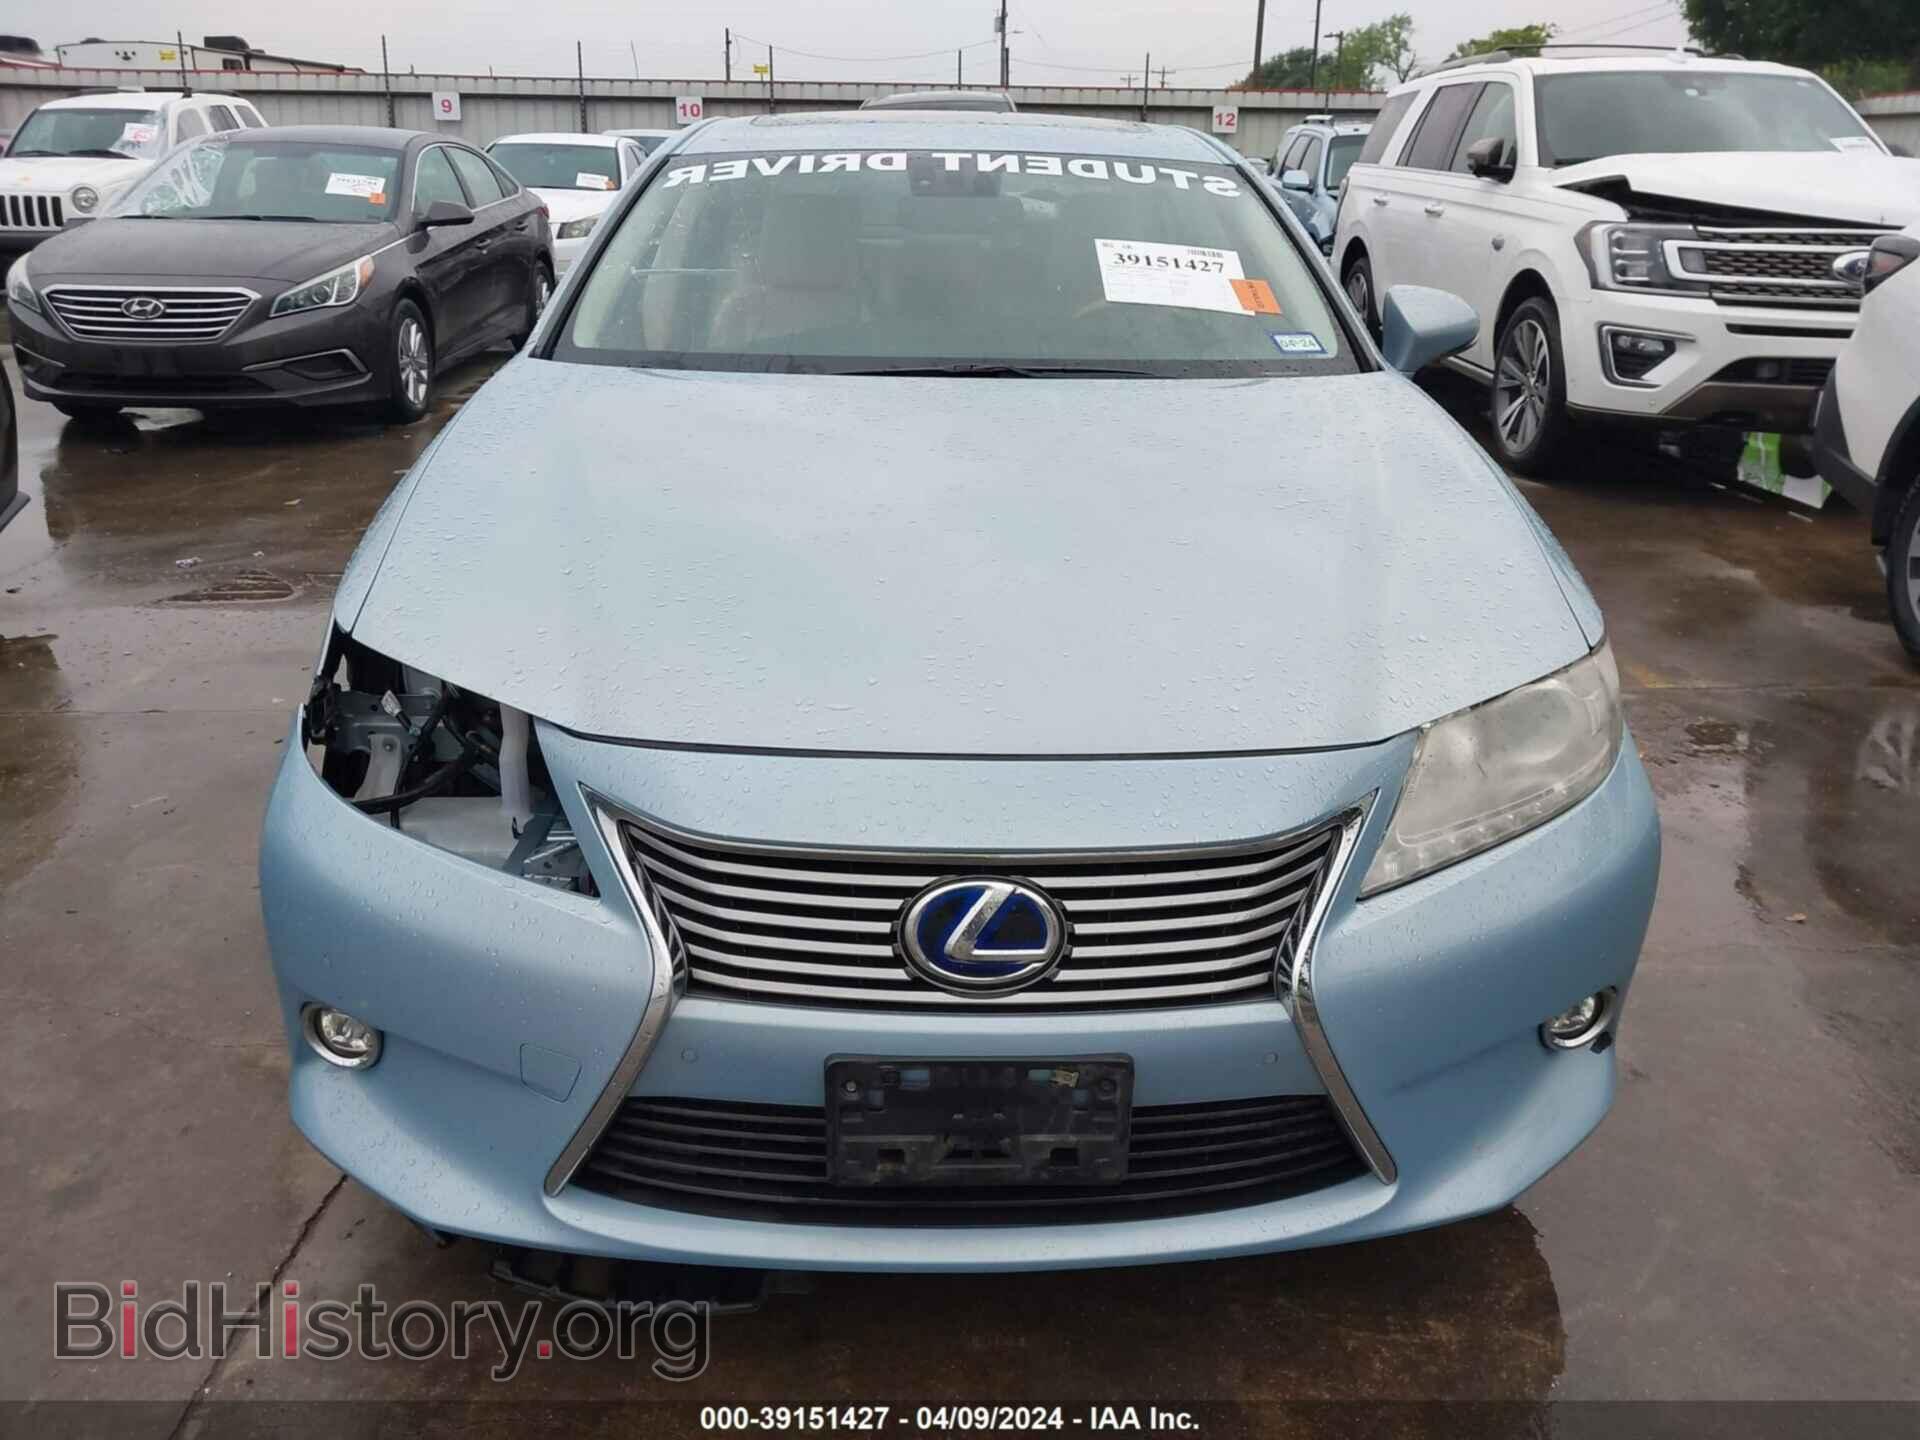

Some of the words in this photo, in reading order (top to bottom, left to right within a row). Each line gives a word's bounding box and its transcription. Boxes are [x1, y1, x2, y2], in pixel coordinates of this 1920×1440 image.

[441, 98, 453, 113] 9
[679, 103, 701, 118] 10
[1215, 112, 1236, 127] 12
[1113, 252, 1225, 273] 39151427
